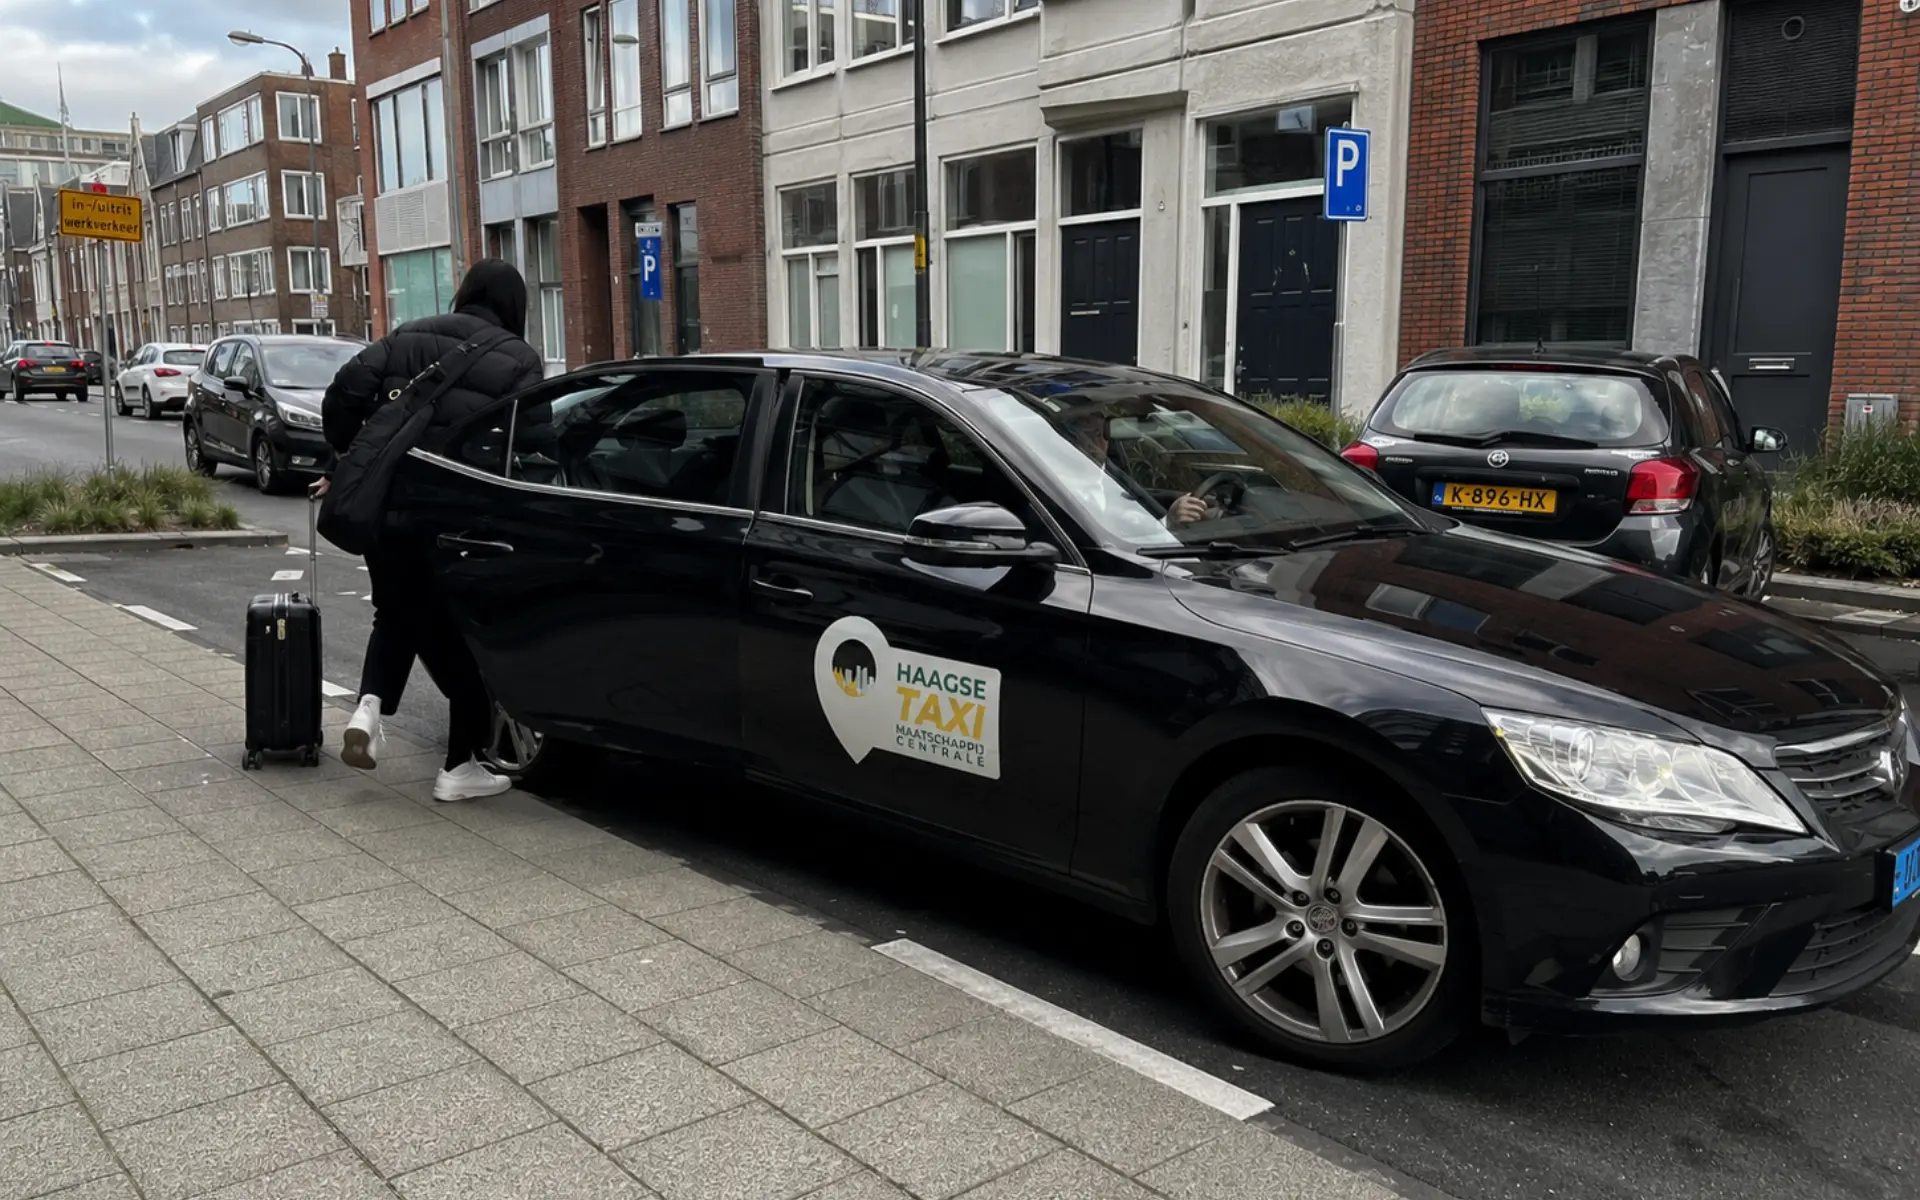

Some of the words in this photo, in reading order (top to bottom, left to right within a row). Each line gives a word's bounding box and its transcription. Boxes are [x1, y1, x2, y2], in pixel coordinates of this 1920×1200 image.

[1336, 139, 1360, 187] P
[64, 216, 138, 234] werkverkeer
[643, 254, 656, 281] P
[1450, 486, 1548, 510] K-896-HX
[896, 661, 987, 701] HAAGSE
[895, 685, 986, 741] TAXI
[895, 735, 986, 768] CENTRALE
